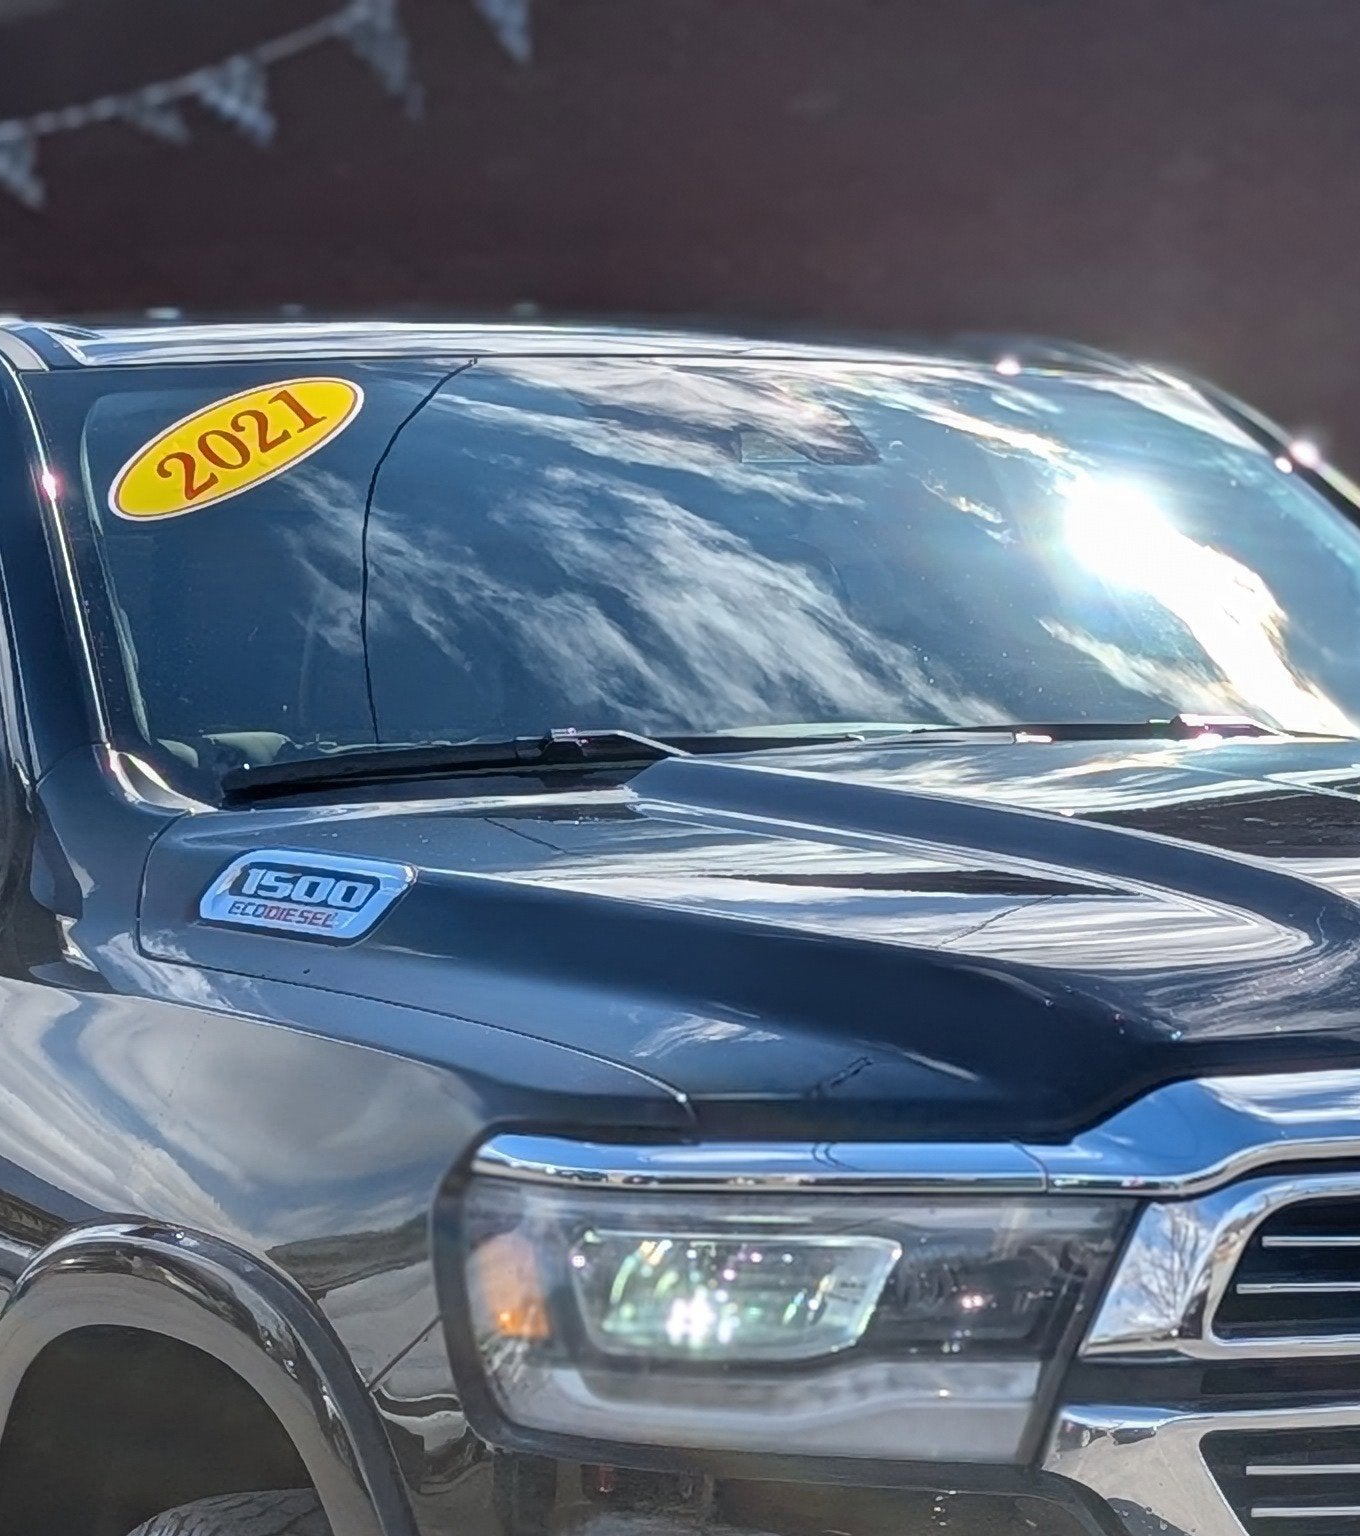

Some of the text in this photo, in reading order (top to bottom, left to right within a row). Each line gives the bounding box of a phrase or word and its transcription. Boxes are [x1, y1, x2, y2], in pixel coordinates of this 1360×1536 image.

[156, 389, 328, 500] 2021
[241, 868, 374, 909] 1500
[228, 900, 339, 928] ECODIESEL
